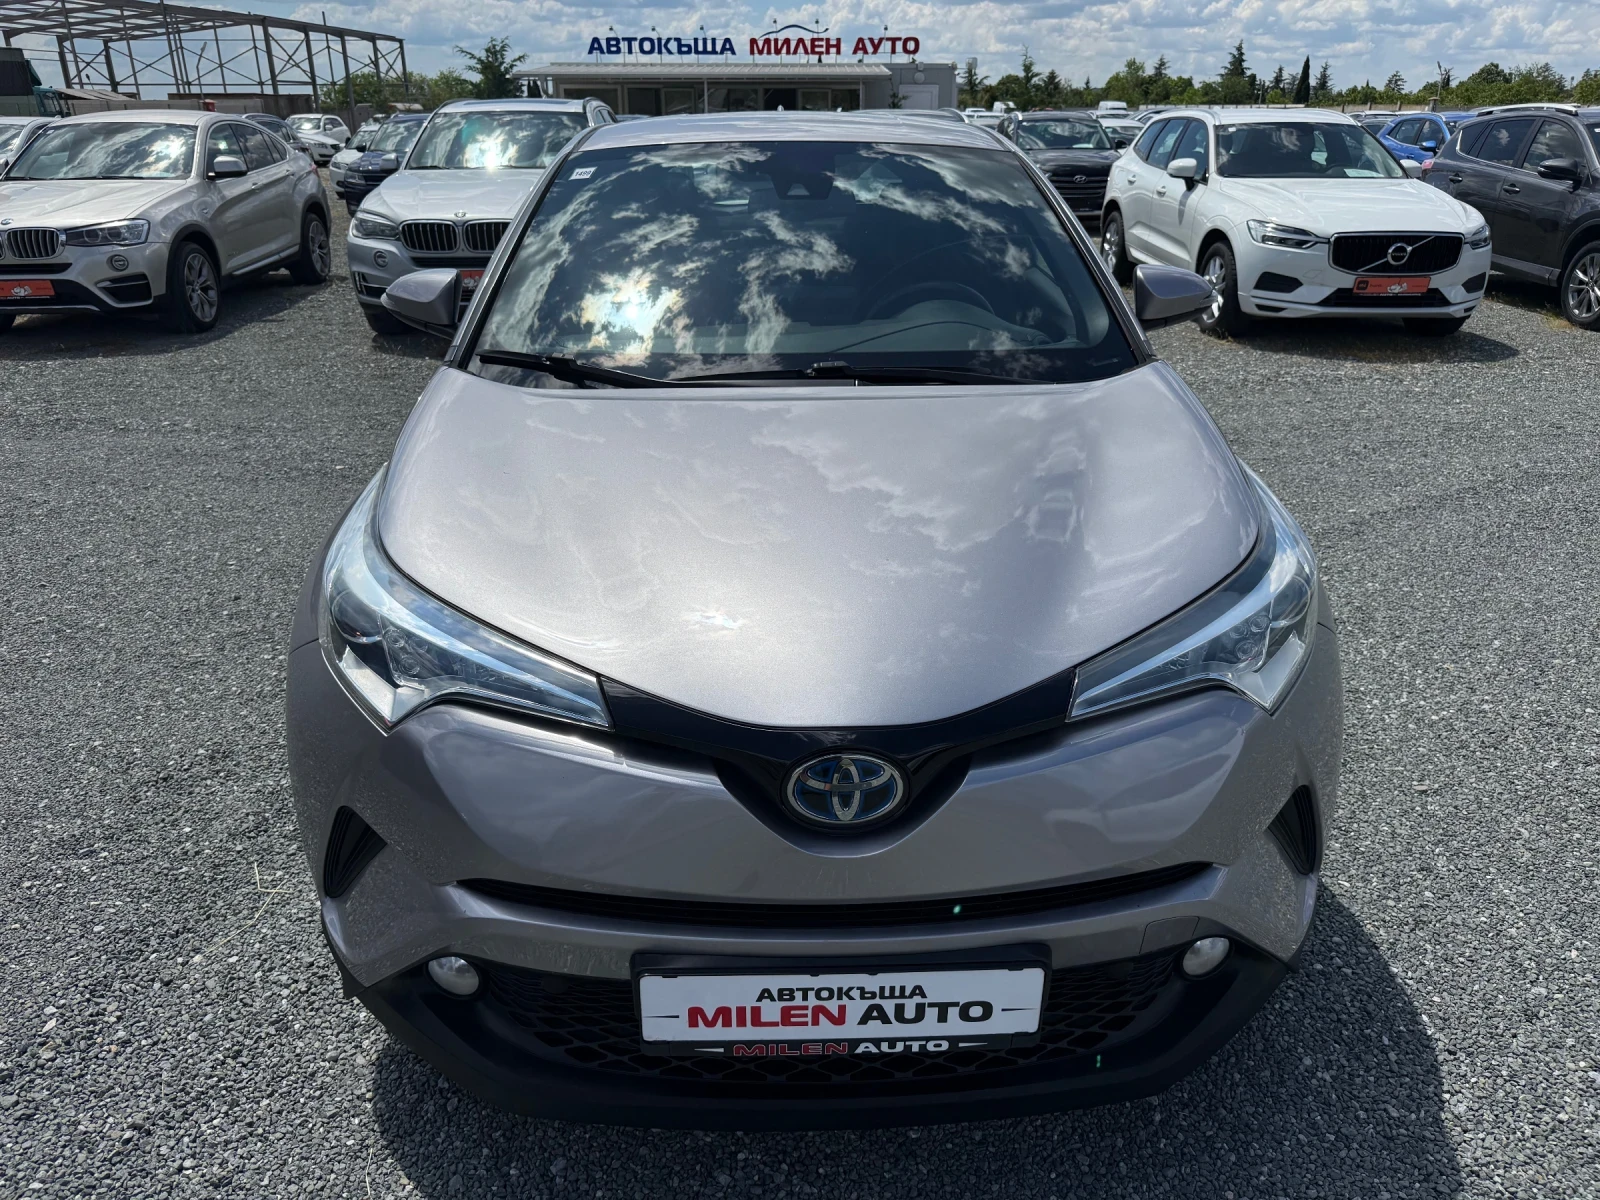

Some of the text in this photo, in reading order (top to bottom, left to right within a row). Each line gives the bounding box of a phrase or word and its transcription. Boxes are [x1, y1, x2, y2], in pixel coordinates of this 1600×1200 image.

[587, 37, 920, 56] АВТОКЪЩА МИЛЕН АУТО
[755, 984, 927, 1002] АВТОКЪЩА
[687, 1000, 993, 1028] MILEN AUTO
[733, 1039, 949, 1056] MILEN AUTO
